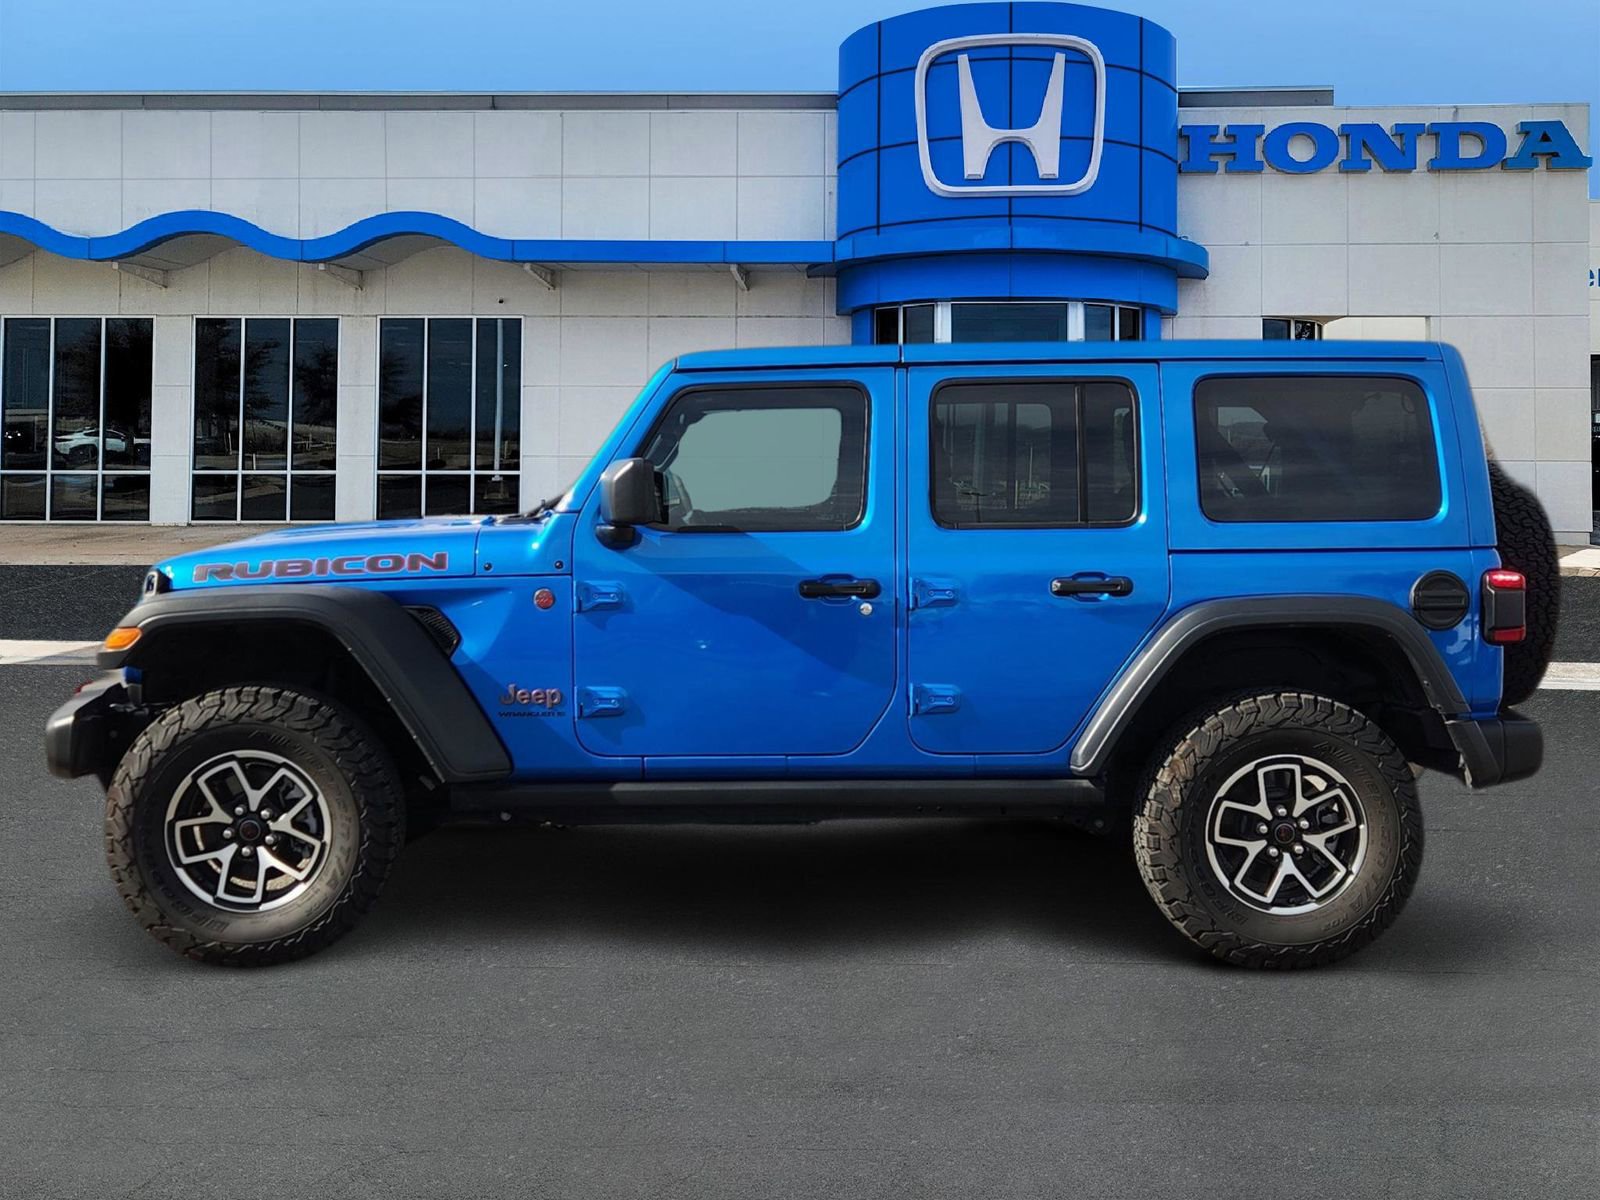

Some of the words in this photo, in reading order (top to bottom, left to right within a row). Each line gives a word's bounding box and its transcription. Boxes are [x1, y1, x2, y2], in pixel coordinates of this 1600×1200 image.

[1179, 120, 1593, 173] HONDA
[193, 551, 449, 582] RUBICON
[501, 683, 561, 709] Jeep
